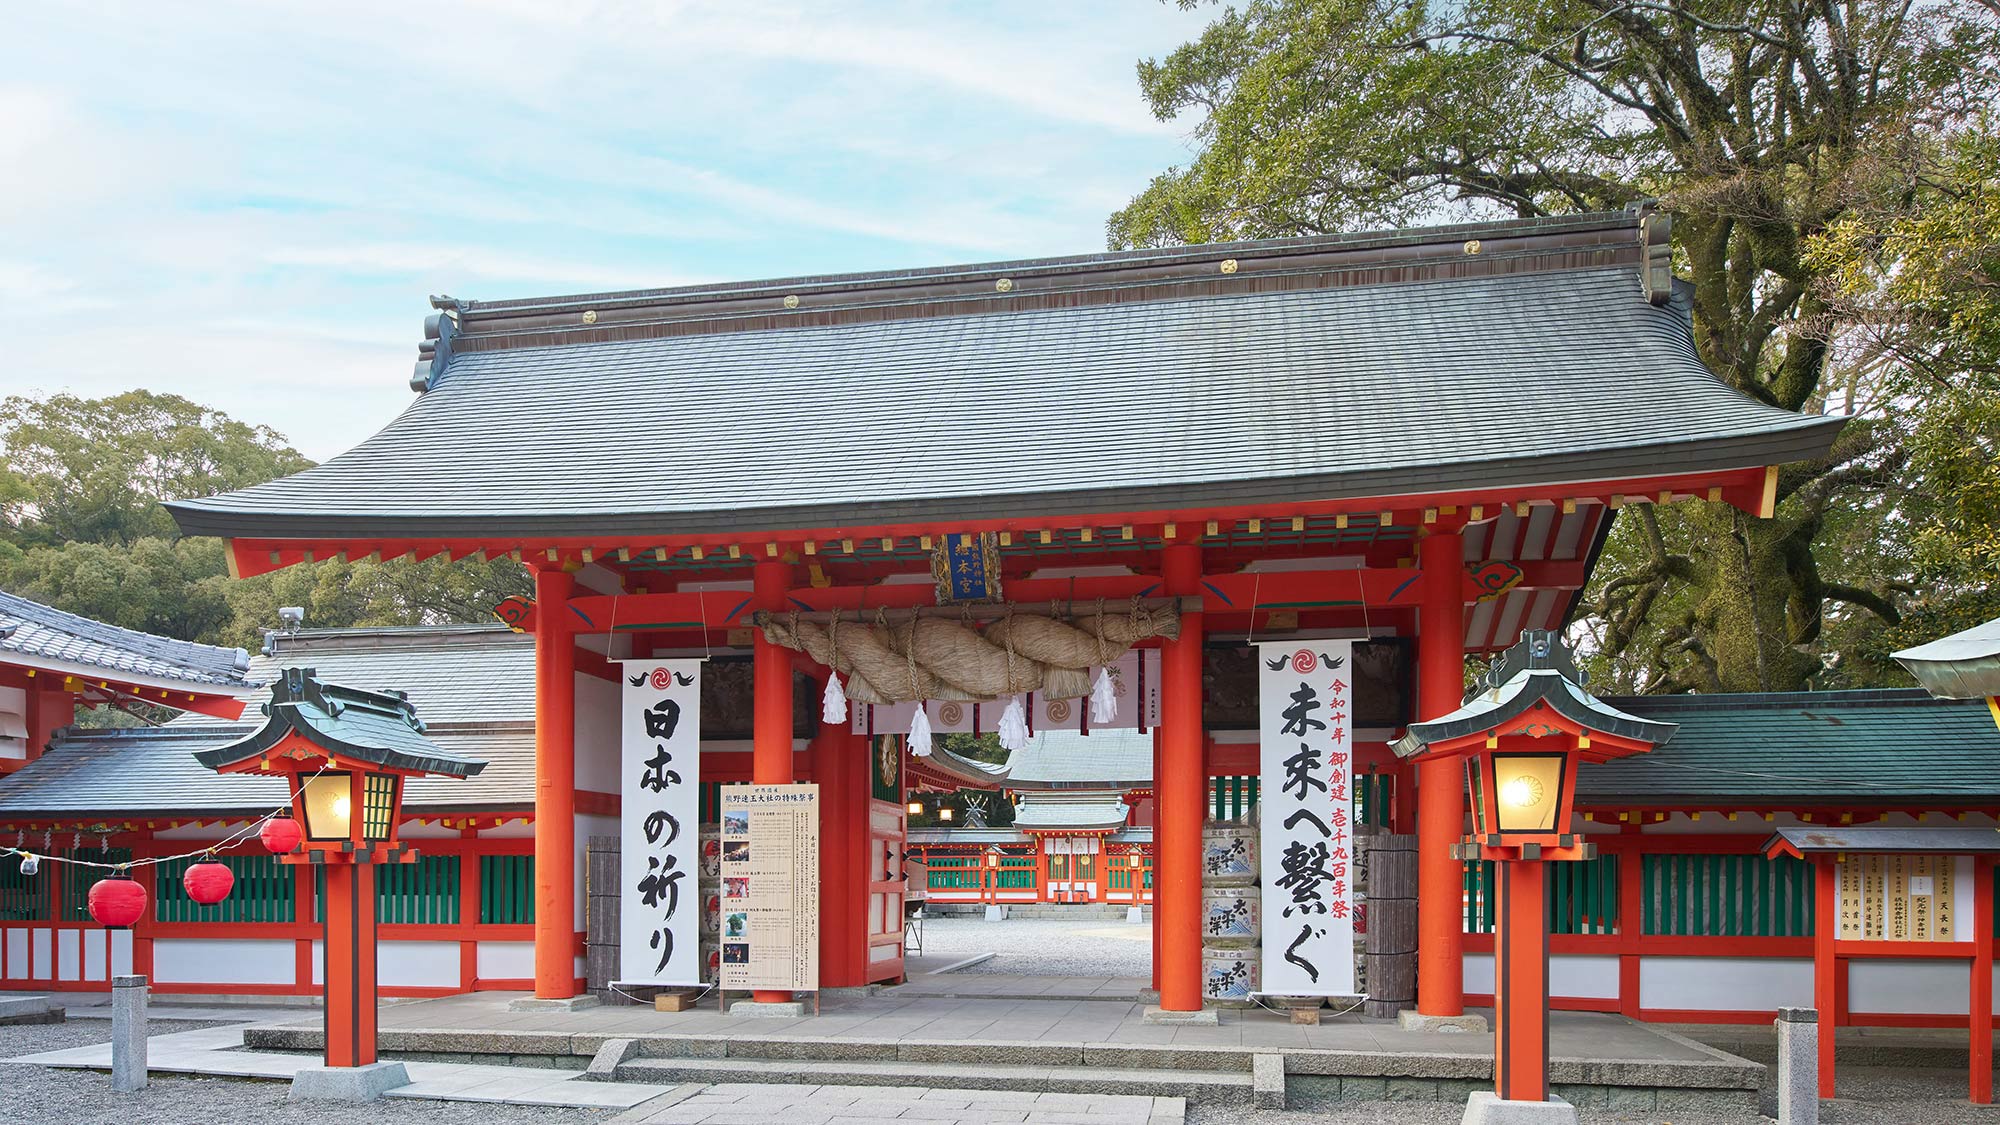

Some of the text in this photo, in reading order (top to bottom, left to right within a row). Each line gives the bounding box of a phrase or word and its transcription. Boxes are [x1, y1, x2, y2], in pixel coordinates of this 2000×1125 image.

[1328, 679, 1350, 919] 令和十年 御創建 壱千九百年祭
[637, 699, 686, 976] 日本の祈り
[1274, 682, 1336, 984] 未来へ繋ぐ
[1208, 838, 1246, 876] 太平洋
[1209, 899, 1248, 936] 太平洋
[1940, 902, 1949, 935] 天長祭
[1208, 961, 1247, 997] 太平洋
